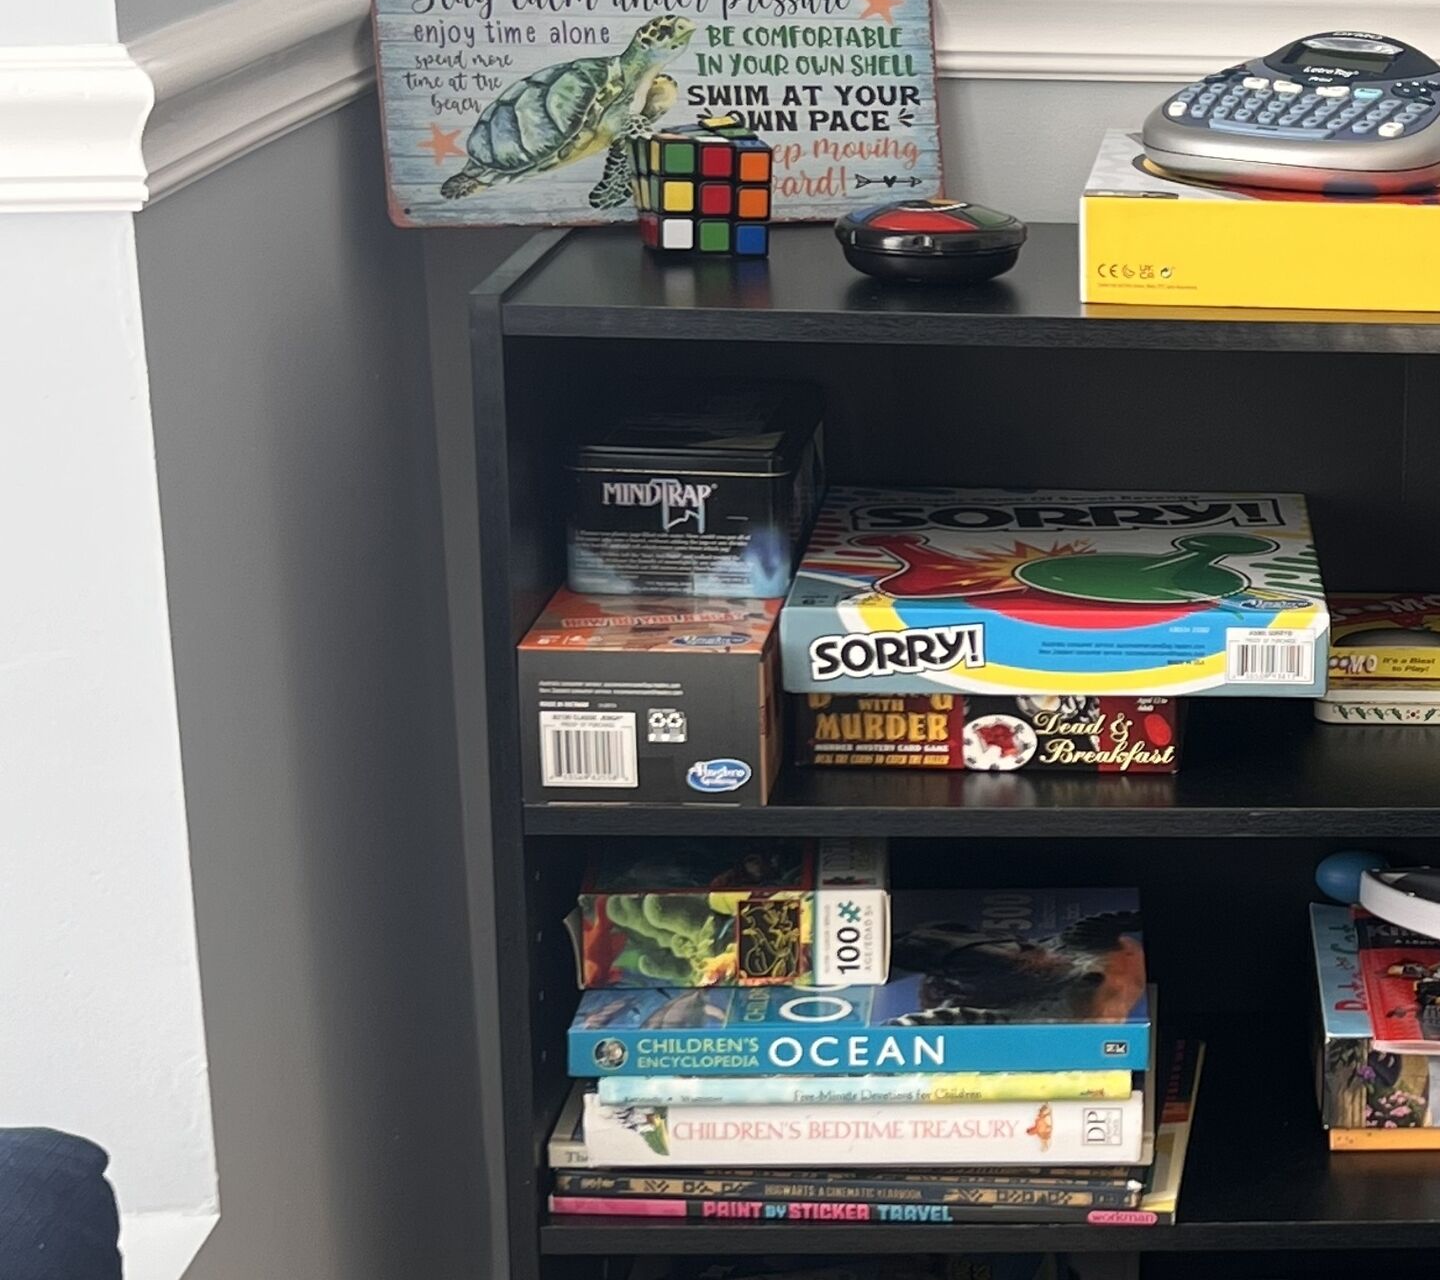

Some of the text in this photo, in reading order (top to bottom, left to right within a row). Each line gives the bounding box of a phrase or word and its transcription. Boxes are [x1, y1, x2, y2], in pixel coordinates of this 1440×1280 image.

[414, 20, 611, 48] enjoy time alone
[706, 25, 903, 48] BE COMFORTABLE
[415, 51, 514, 69] spend more
[696, 53, 918, 77] IN YOUR OWN SHELL
[403, 73, 502, 92] time at the
[431, 93, 482, 115] beach
[687, 85, 921, 107] SWIM AT YOUR
[809, 110, 890, 131] PACE
[814, 138, 921, 169] moving
[867, 503, 1267, 528] SORRY!
[816, 630, 979, 676] SORRY!
[858, 699, 904, 712] WITH
[815, 713, 949, 741] MURDER
[1034, 711, 1133, 742] Dead &
[1040, 739, 1175, 770] Breakfast
[837, 926, 861, 976] 100
[637, 1036, 945, 1067] CHILDREN'S OCEAN
[637, 1055, 760, 1069] ENCYCLOPEDIA
[673, 1120, 1020, 1140] CHILDREN'S BEDTIME TREASURY
[703, 1201, 954, 1222] PAINT BY STICKER TRAVEL
[1091, 1213, 1154, 1223] workman
